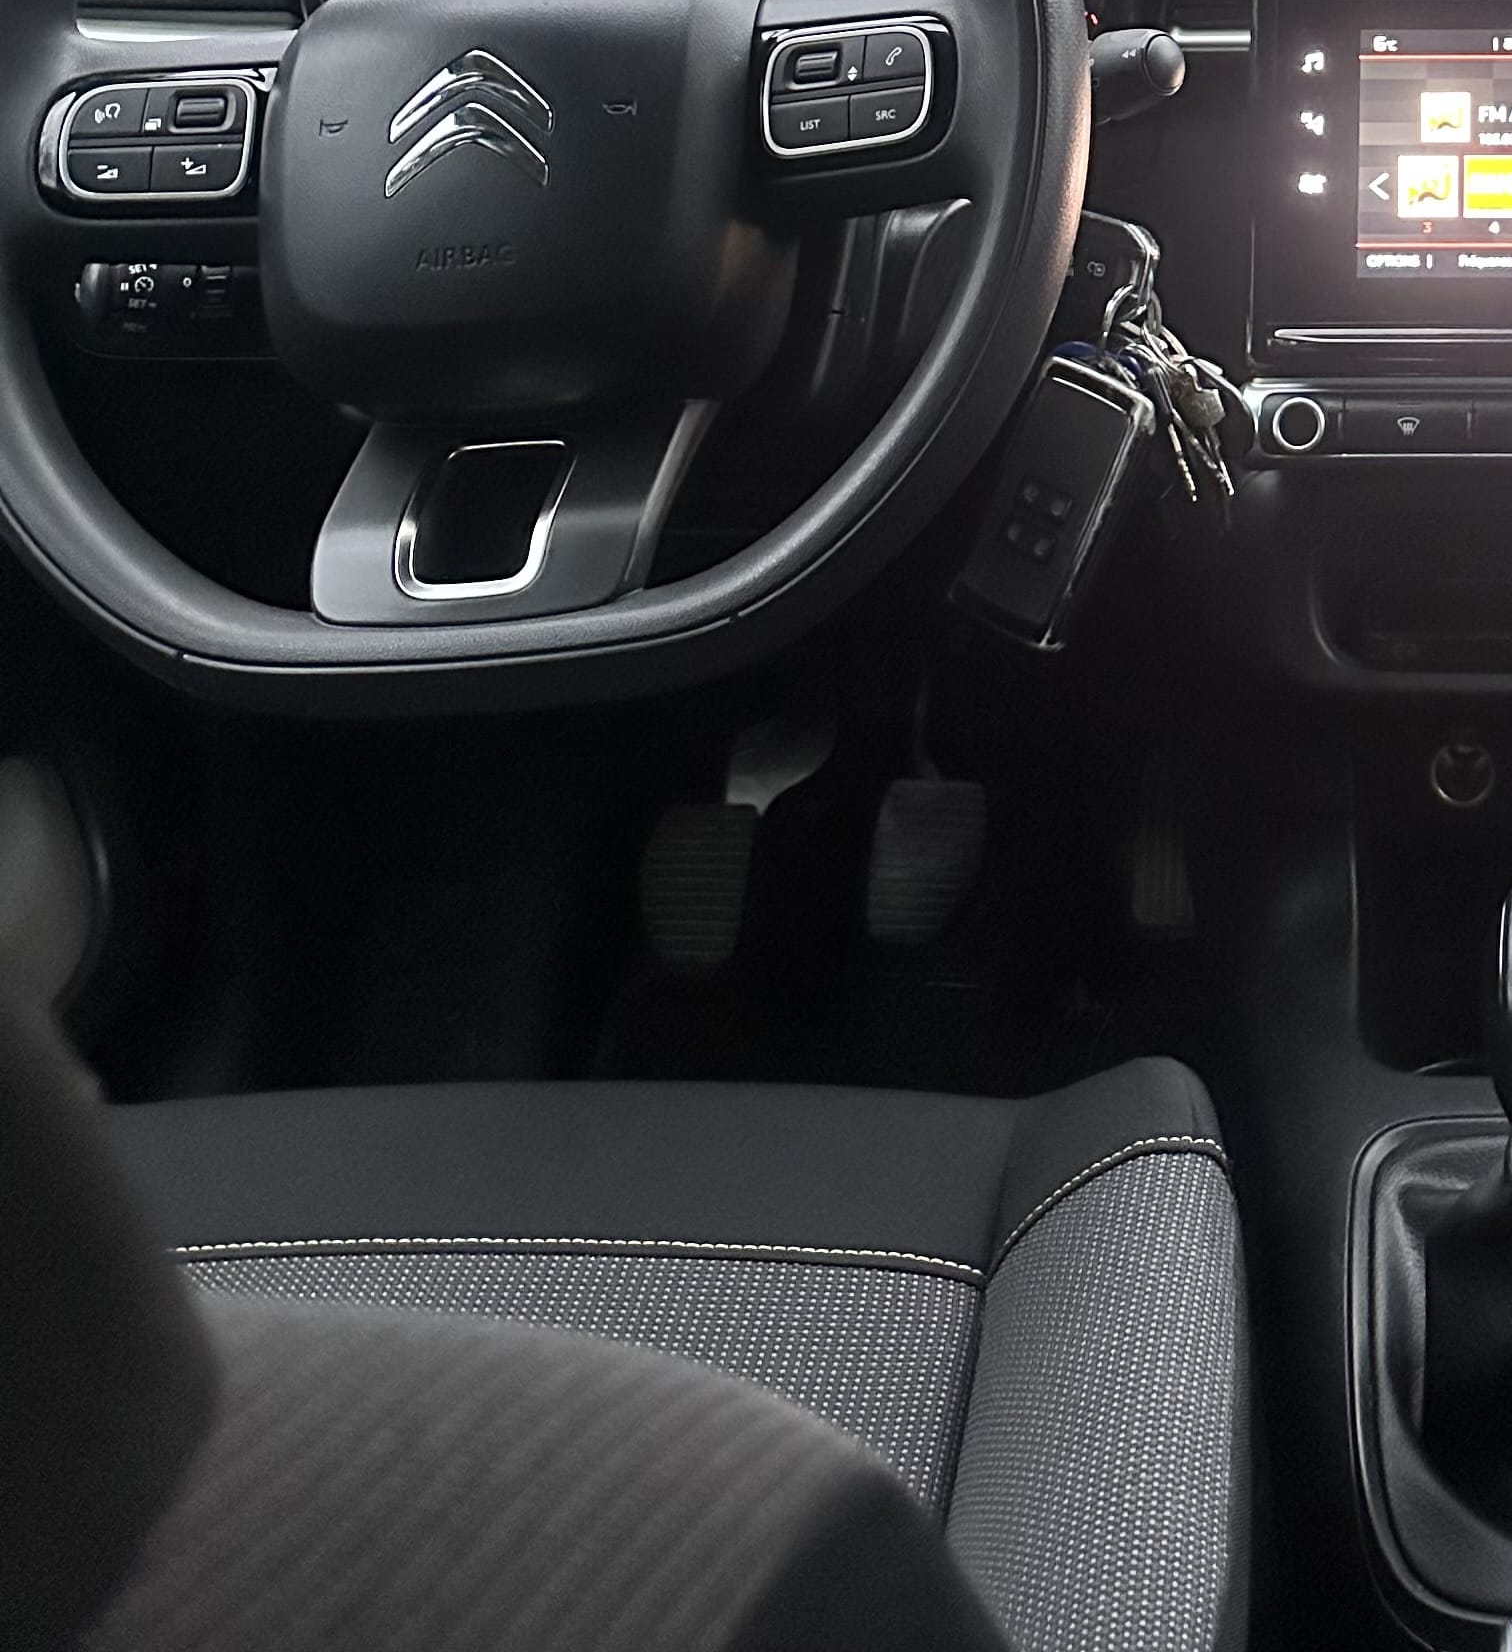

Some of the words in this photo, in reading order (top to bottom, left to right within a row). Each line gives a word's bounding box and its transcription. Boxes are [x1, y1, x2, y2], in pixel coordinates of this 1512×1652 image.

[875, 108, 896, 121] SRC
[800, 118, 821, 131] LIST
[1422, 221, 1433, 234] 3
[415, 244, 517, 272] AIRBAG
